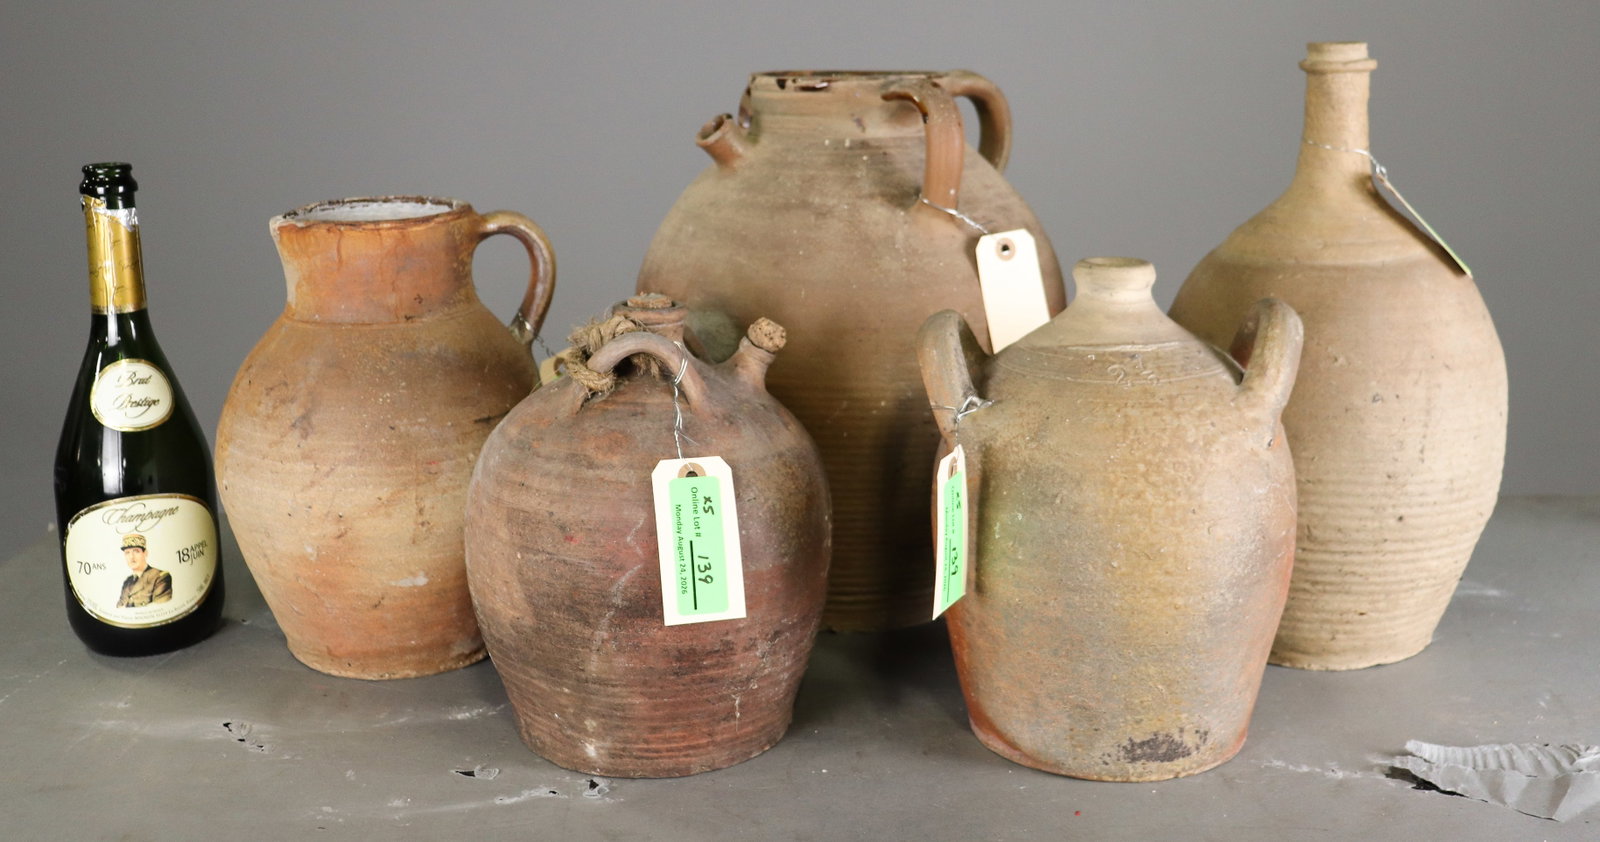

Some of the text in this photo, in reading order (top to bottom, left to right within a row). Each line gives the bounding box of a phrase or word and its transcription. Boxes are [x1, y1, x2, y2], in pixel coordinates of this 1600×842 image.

[116, 370, 153, 387] Brut
[112, 393, 160, 419] Prestige
[690, 486, 699, 515] Online
[102, 502, 179, 534] Champagne
[675, 504, 683, 535] Monday
[693, 515, 701, 530] Lot
[175, 540, 208, 564] 18 APPEL
[190, 549, 205, 566] JUIN
[677, 536, 685, 562] August
[951, 546, 959, 576] 139
[77, 560, 107, 575] 70 ANS
[697, 555, 714, 584] 139
[680, 577, 688, 595] 2026
